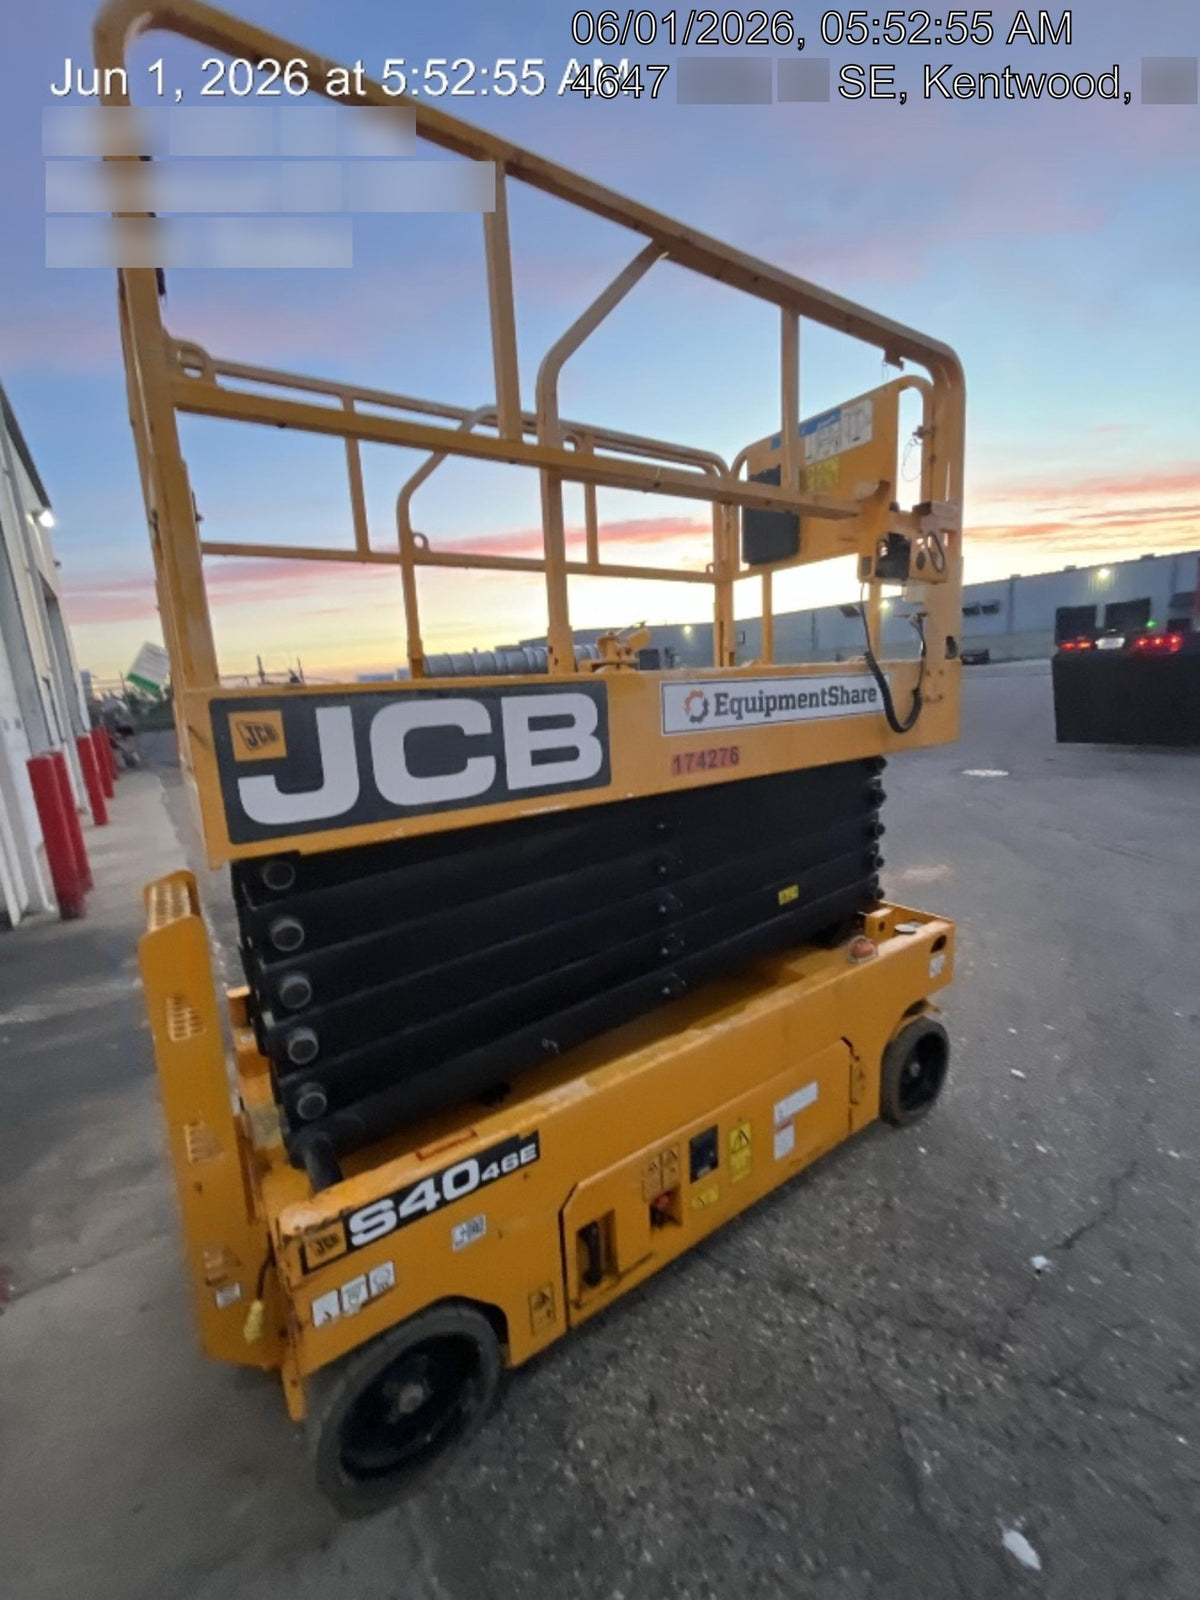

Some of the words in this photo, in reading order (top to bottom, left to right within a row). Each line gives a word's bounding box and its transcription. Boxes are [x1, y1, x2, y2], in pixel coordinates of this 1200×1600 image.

[713, 685, 878, 721] EquipmentShare
[237, 692, 603, 825] JCB
[671, 746, 740, 776] 174276
